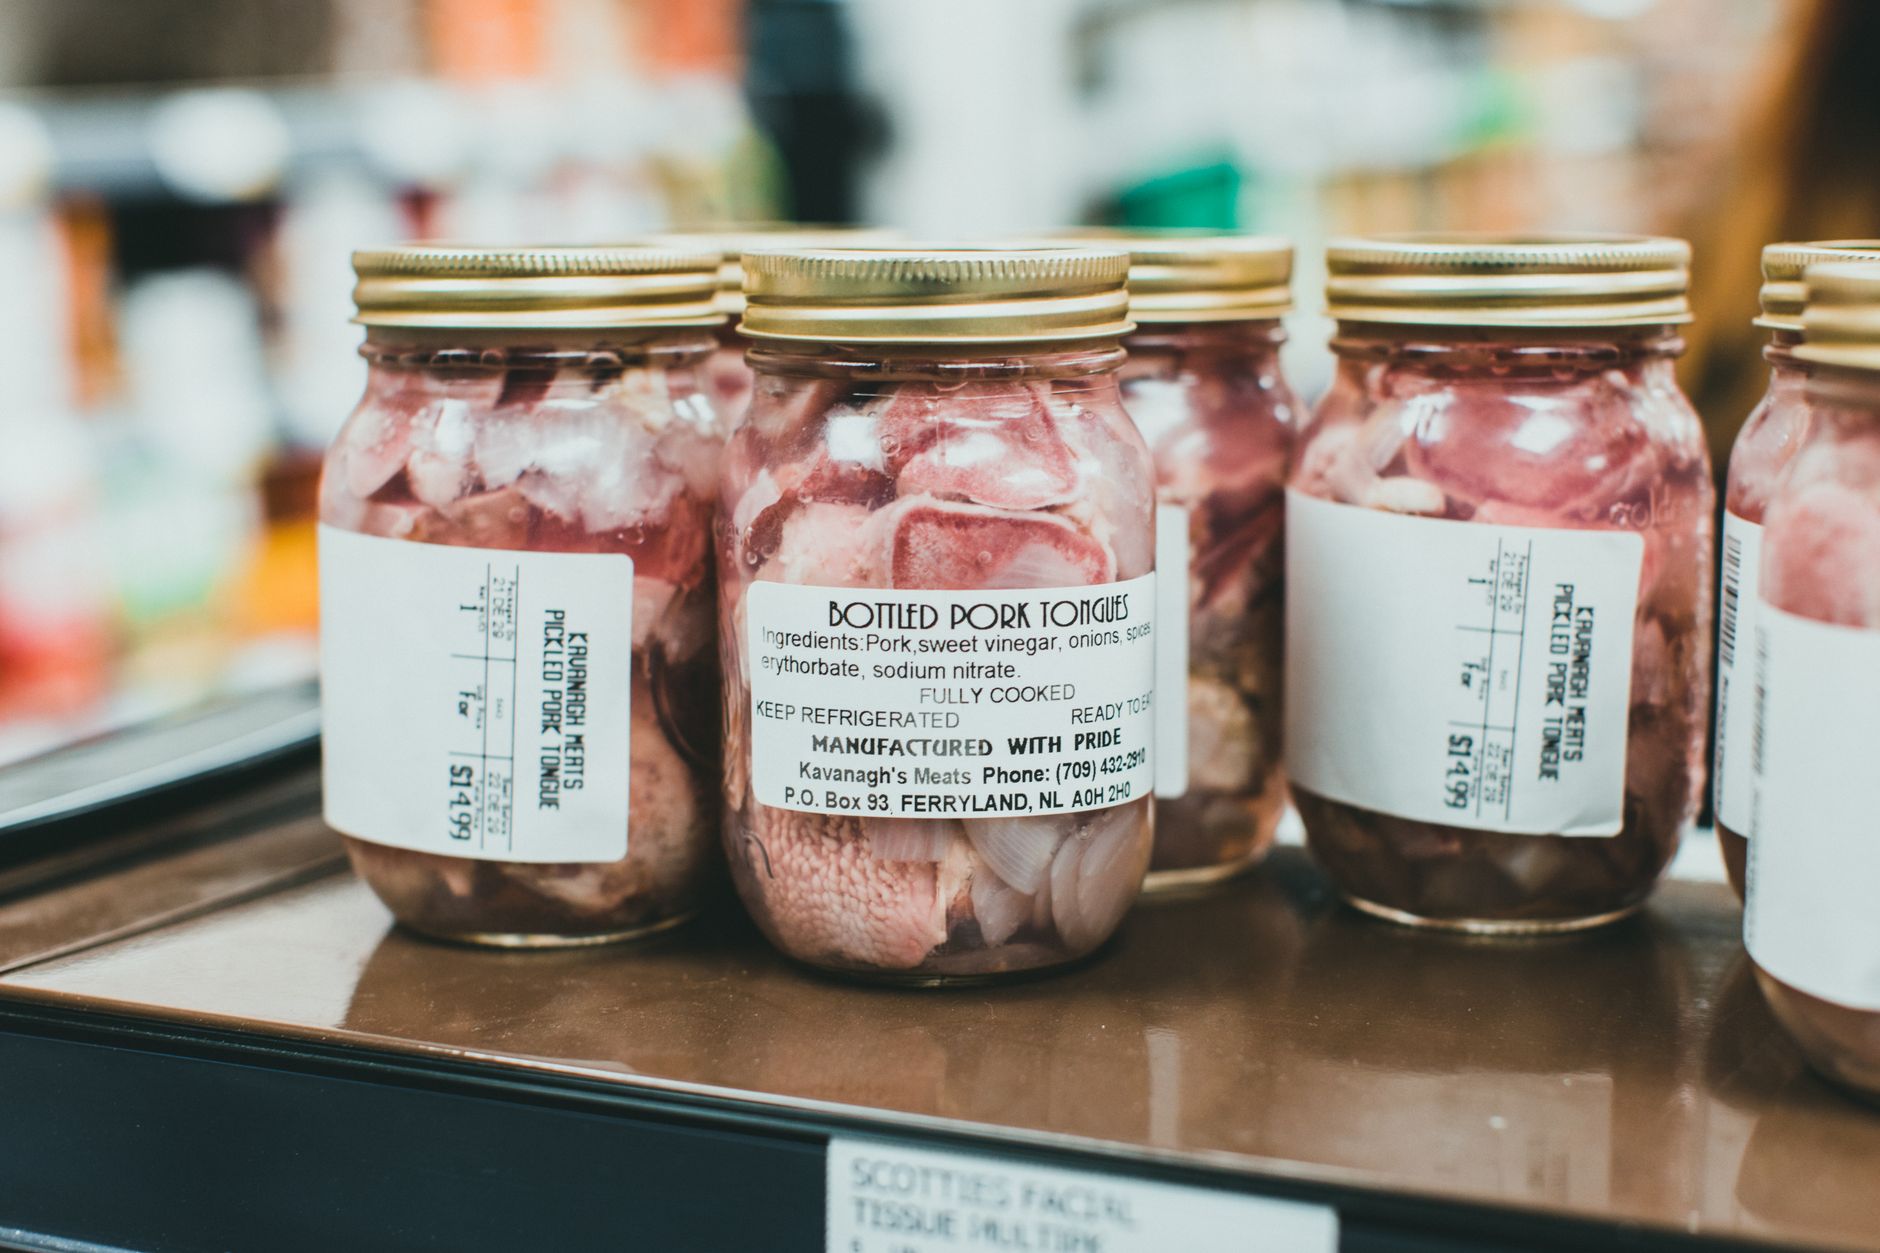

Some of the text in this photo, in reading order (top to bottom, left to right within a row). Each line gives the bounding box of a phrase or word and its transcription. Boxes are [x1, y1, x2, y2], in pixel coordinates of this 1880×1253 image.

[829, 594, 1129, 630] BOTTLED PORK TONGUES
[985, 635, 1062, 656] vinegar,
[1068, 628, 1122, 649] onions,
[761, 654, 1022, 680] erythorbate, sodium nitrate.
[1538, 584, 1574, 782] PICKLED PORK TONGUE
[1564, 606, 1594, 763] KAVANAGH MEATS
[539, 610, 564, 810] PICKLED PORK TONGUE
[564, 632, 588, 790] KAVANAGH MEATS
[920, 683, 1076, 704] FULLY COOKED
[1071, 702, 1123, 725] READY
[1127, 697, 1141, 715] TO
[756, 700, 960, 729] KEEP REFRIGERATED
[812, 727, 1122, 756] MANUFACTURED WITH PRIDE
[799, 748, 1146, 787] Kavanagh's Meats Phone: (709) 432-2910
[784, 786, 820, 808] P.O.
[825, 790, 861, 810] Box
[901, 794, 1033, 813] FERRYLAND,
[1039, 789, 1063, 809] NL
[851, 1156, 1136, 1223] SCOTTIES FACIAL
[851, 1196, 957, 1235] TISSUE
